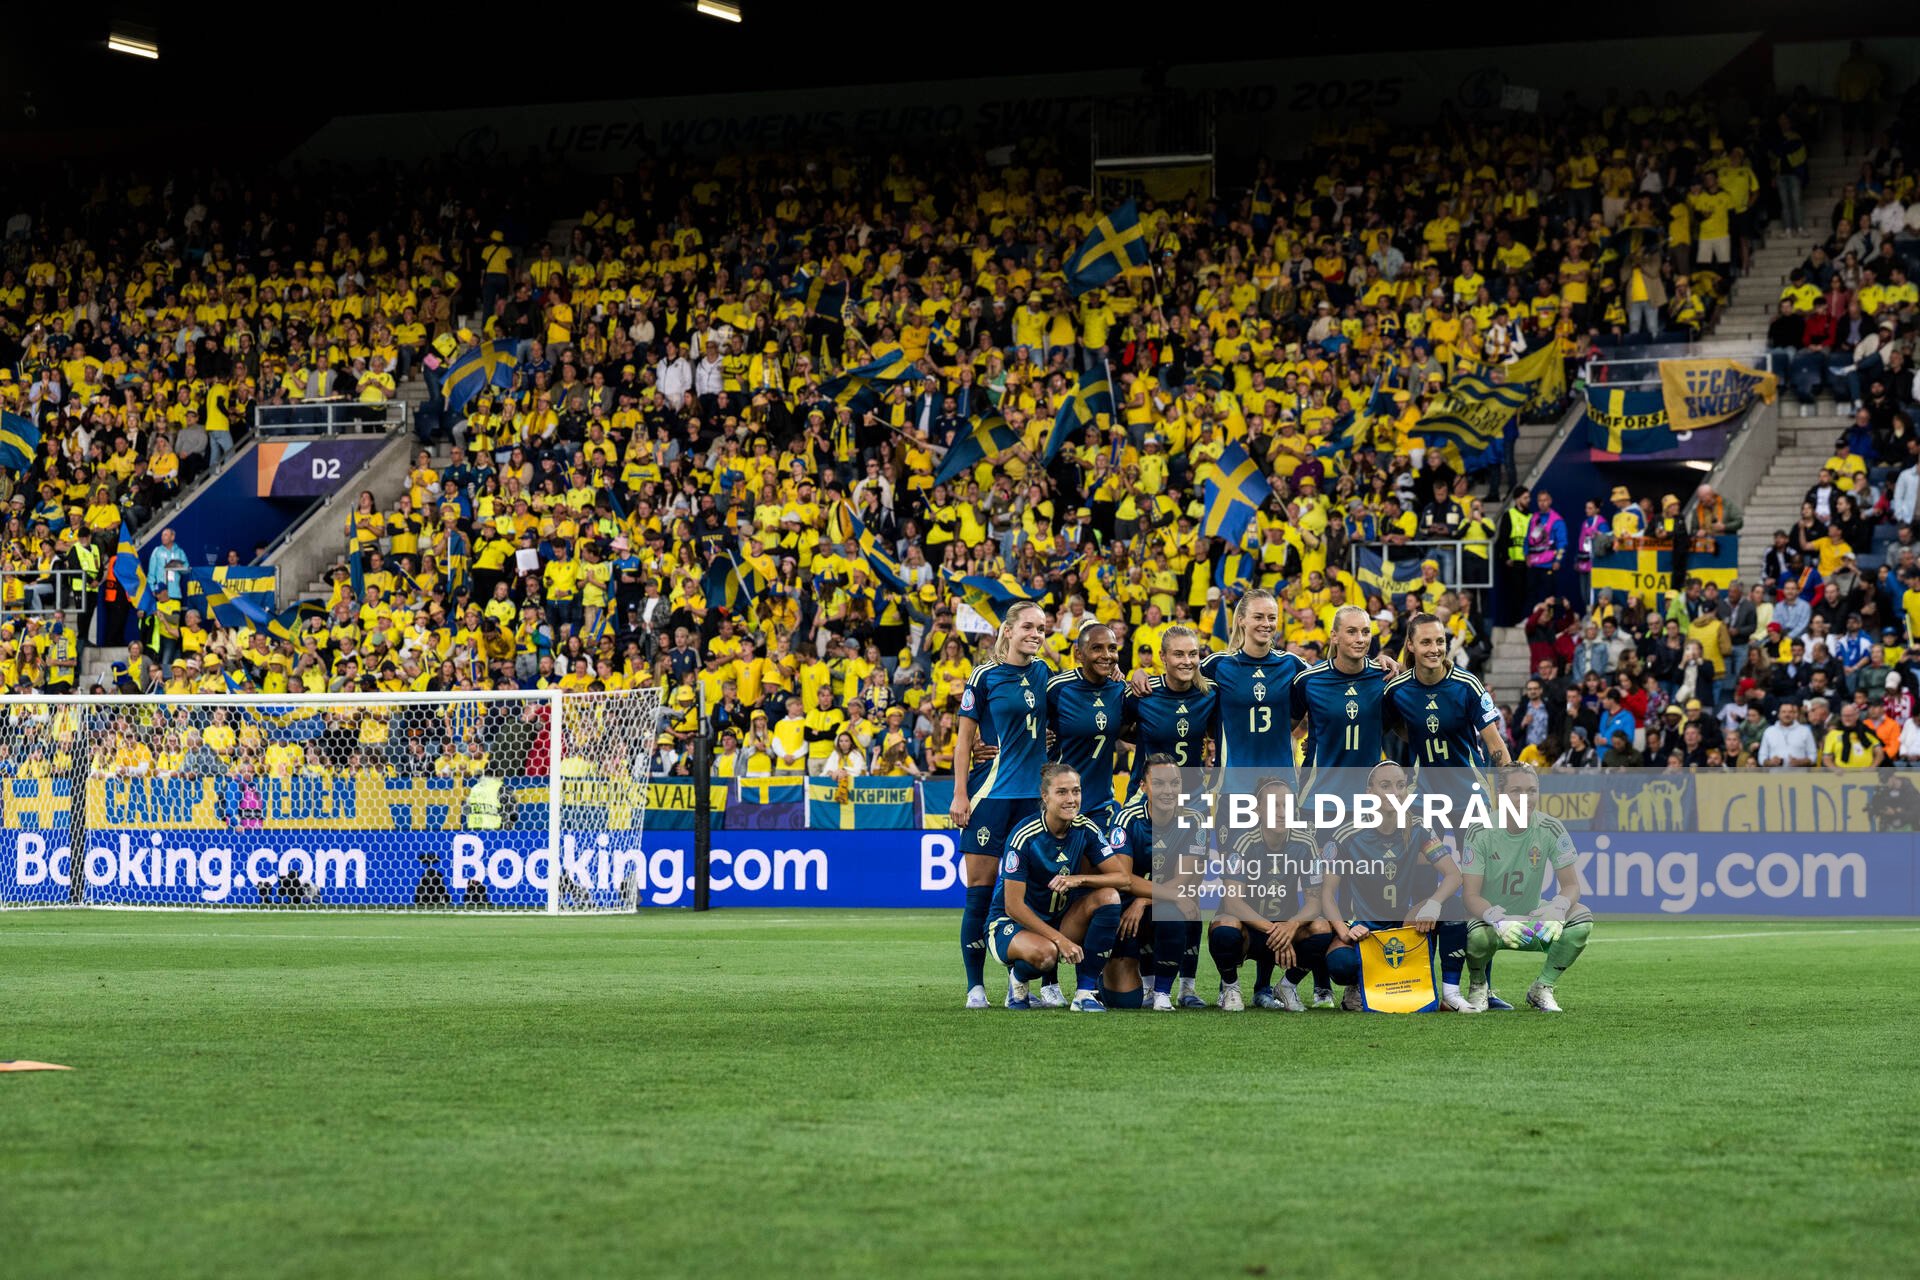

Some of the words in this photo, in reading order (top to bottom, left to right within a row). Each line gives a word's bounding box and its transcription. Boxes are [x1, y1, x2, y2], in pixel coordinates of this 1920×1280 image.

[547, 122, 648, 152] UEFA
[856, 105, 964, 136] EURO
[1288, 77, 1403, 112] 2025
[312, 458, 341, 479] D2
[1025, 713, 1037, 740] 4
[1250, 707, 1272, 733] 13
[1091, 735, 1107, 759] 7
[1345, 724, 1359, 750] 11
[1425, 738, 1449, 762] 14
[1175, 742, 1188, 767] 5
[105, 777, 203, 824] CAMP
[17, 833, 366, 901] Booking.com
[452, 835, 828, 904] Booking.com
[1502, 871, 1525, 895] 12
[1383, 885, 1397, 908] 9
